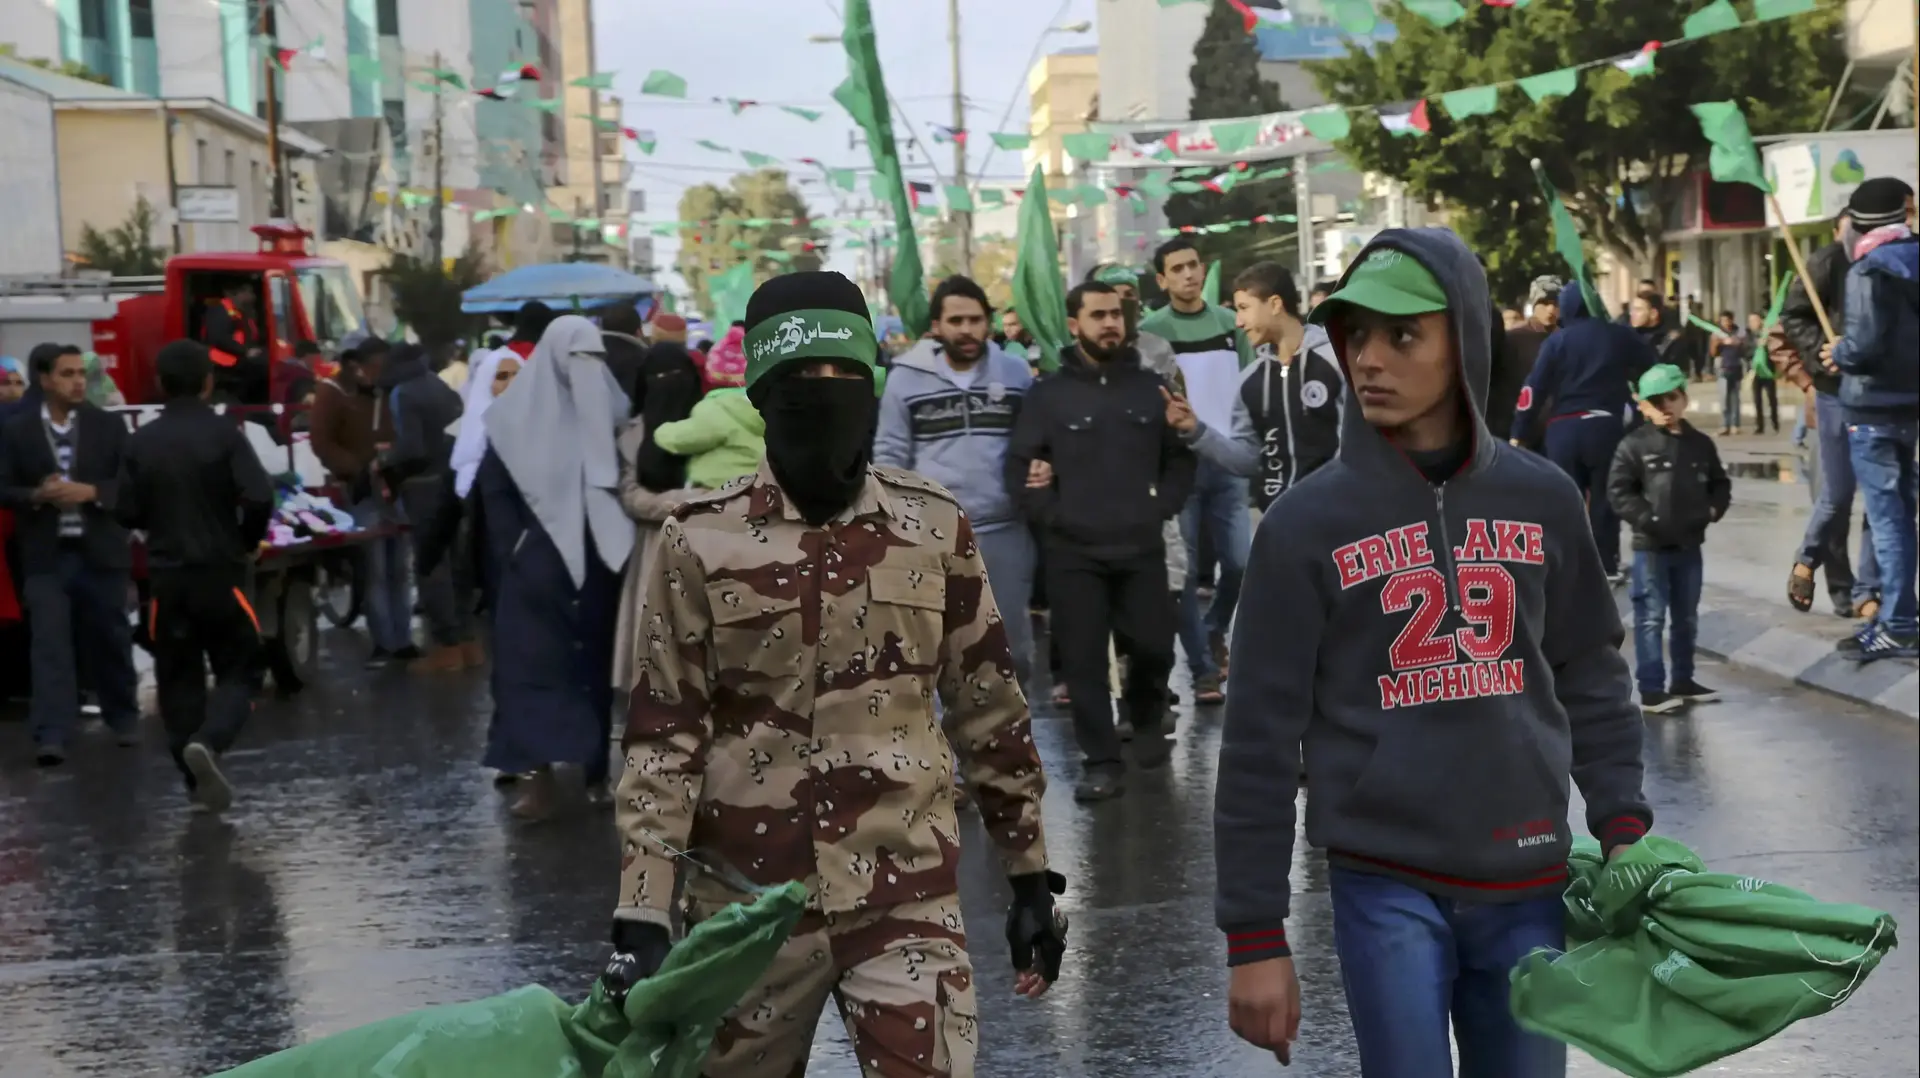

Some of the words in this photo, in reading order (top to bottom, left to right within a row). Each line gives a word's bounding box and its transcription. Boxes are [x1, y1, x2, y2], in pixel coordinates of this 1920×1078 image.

[1332, 521, 1434, 590] ERIE
[1380, 563, 1516, 672] 29
[1378, 658, 1524, 709] MICHIGAN
